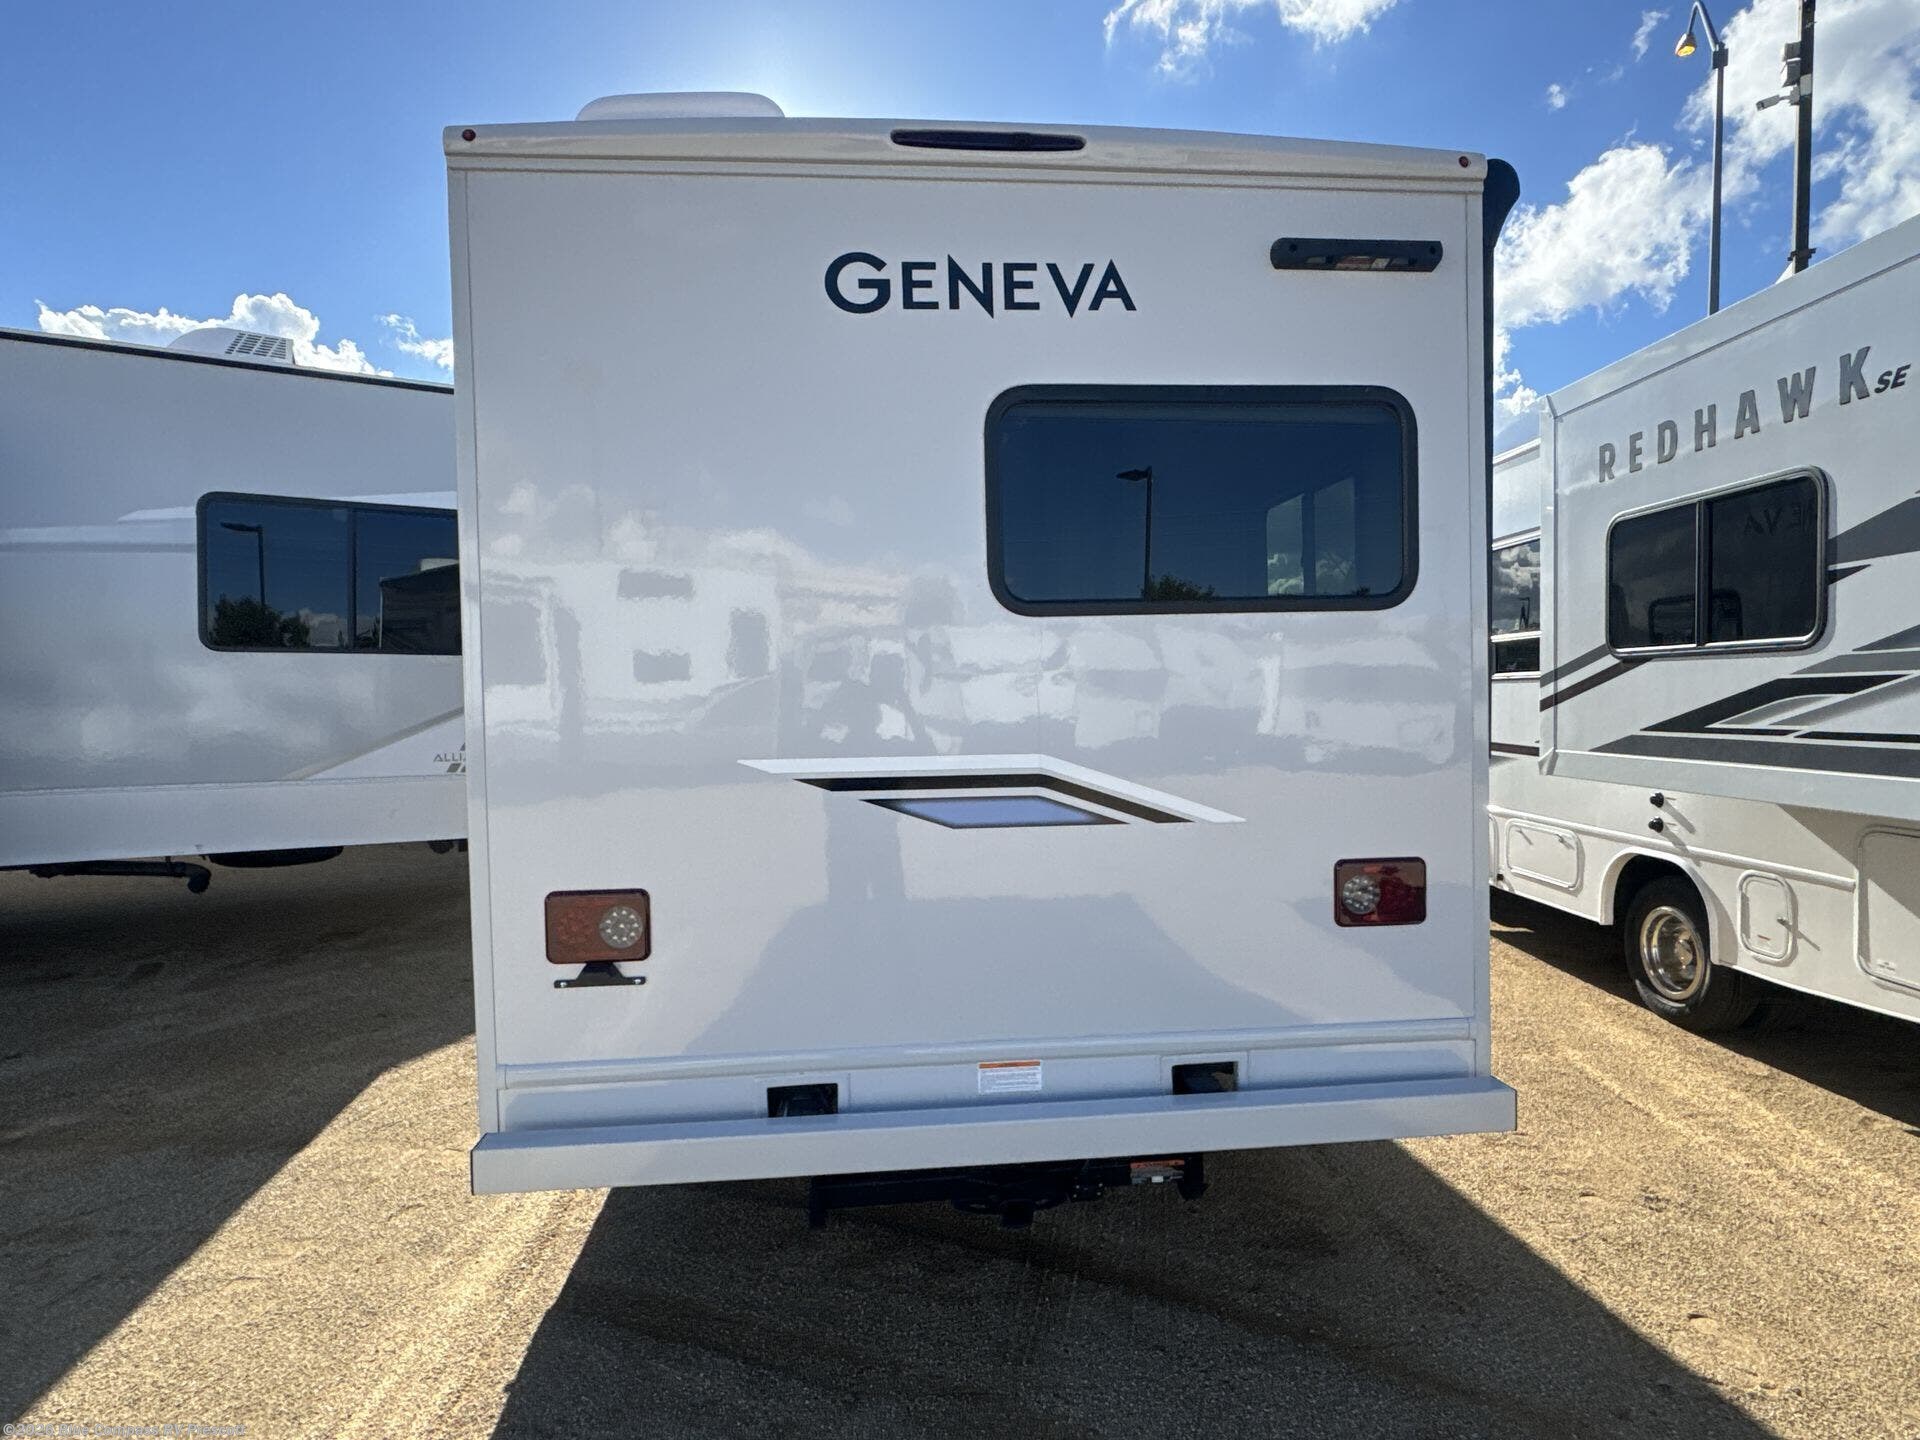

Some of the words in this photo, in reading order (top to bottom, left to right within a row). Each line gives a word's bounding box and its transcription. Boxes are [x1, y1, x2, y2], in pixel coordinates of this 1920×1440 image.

[824, 251, 1137, 319] GENEVA
[1598, 345, 1872, 484] REDHAWK
[1874, 363, 1912, 394] SE
[433, 752, 466, 763] ALLI
